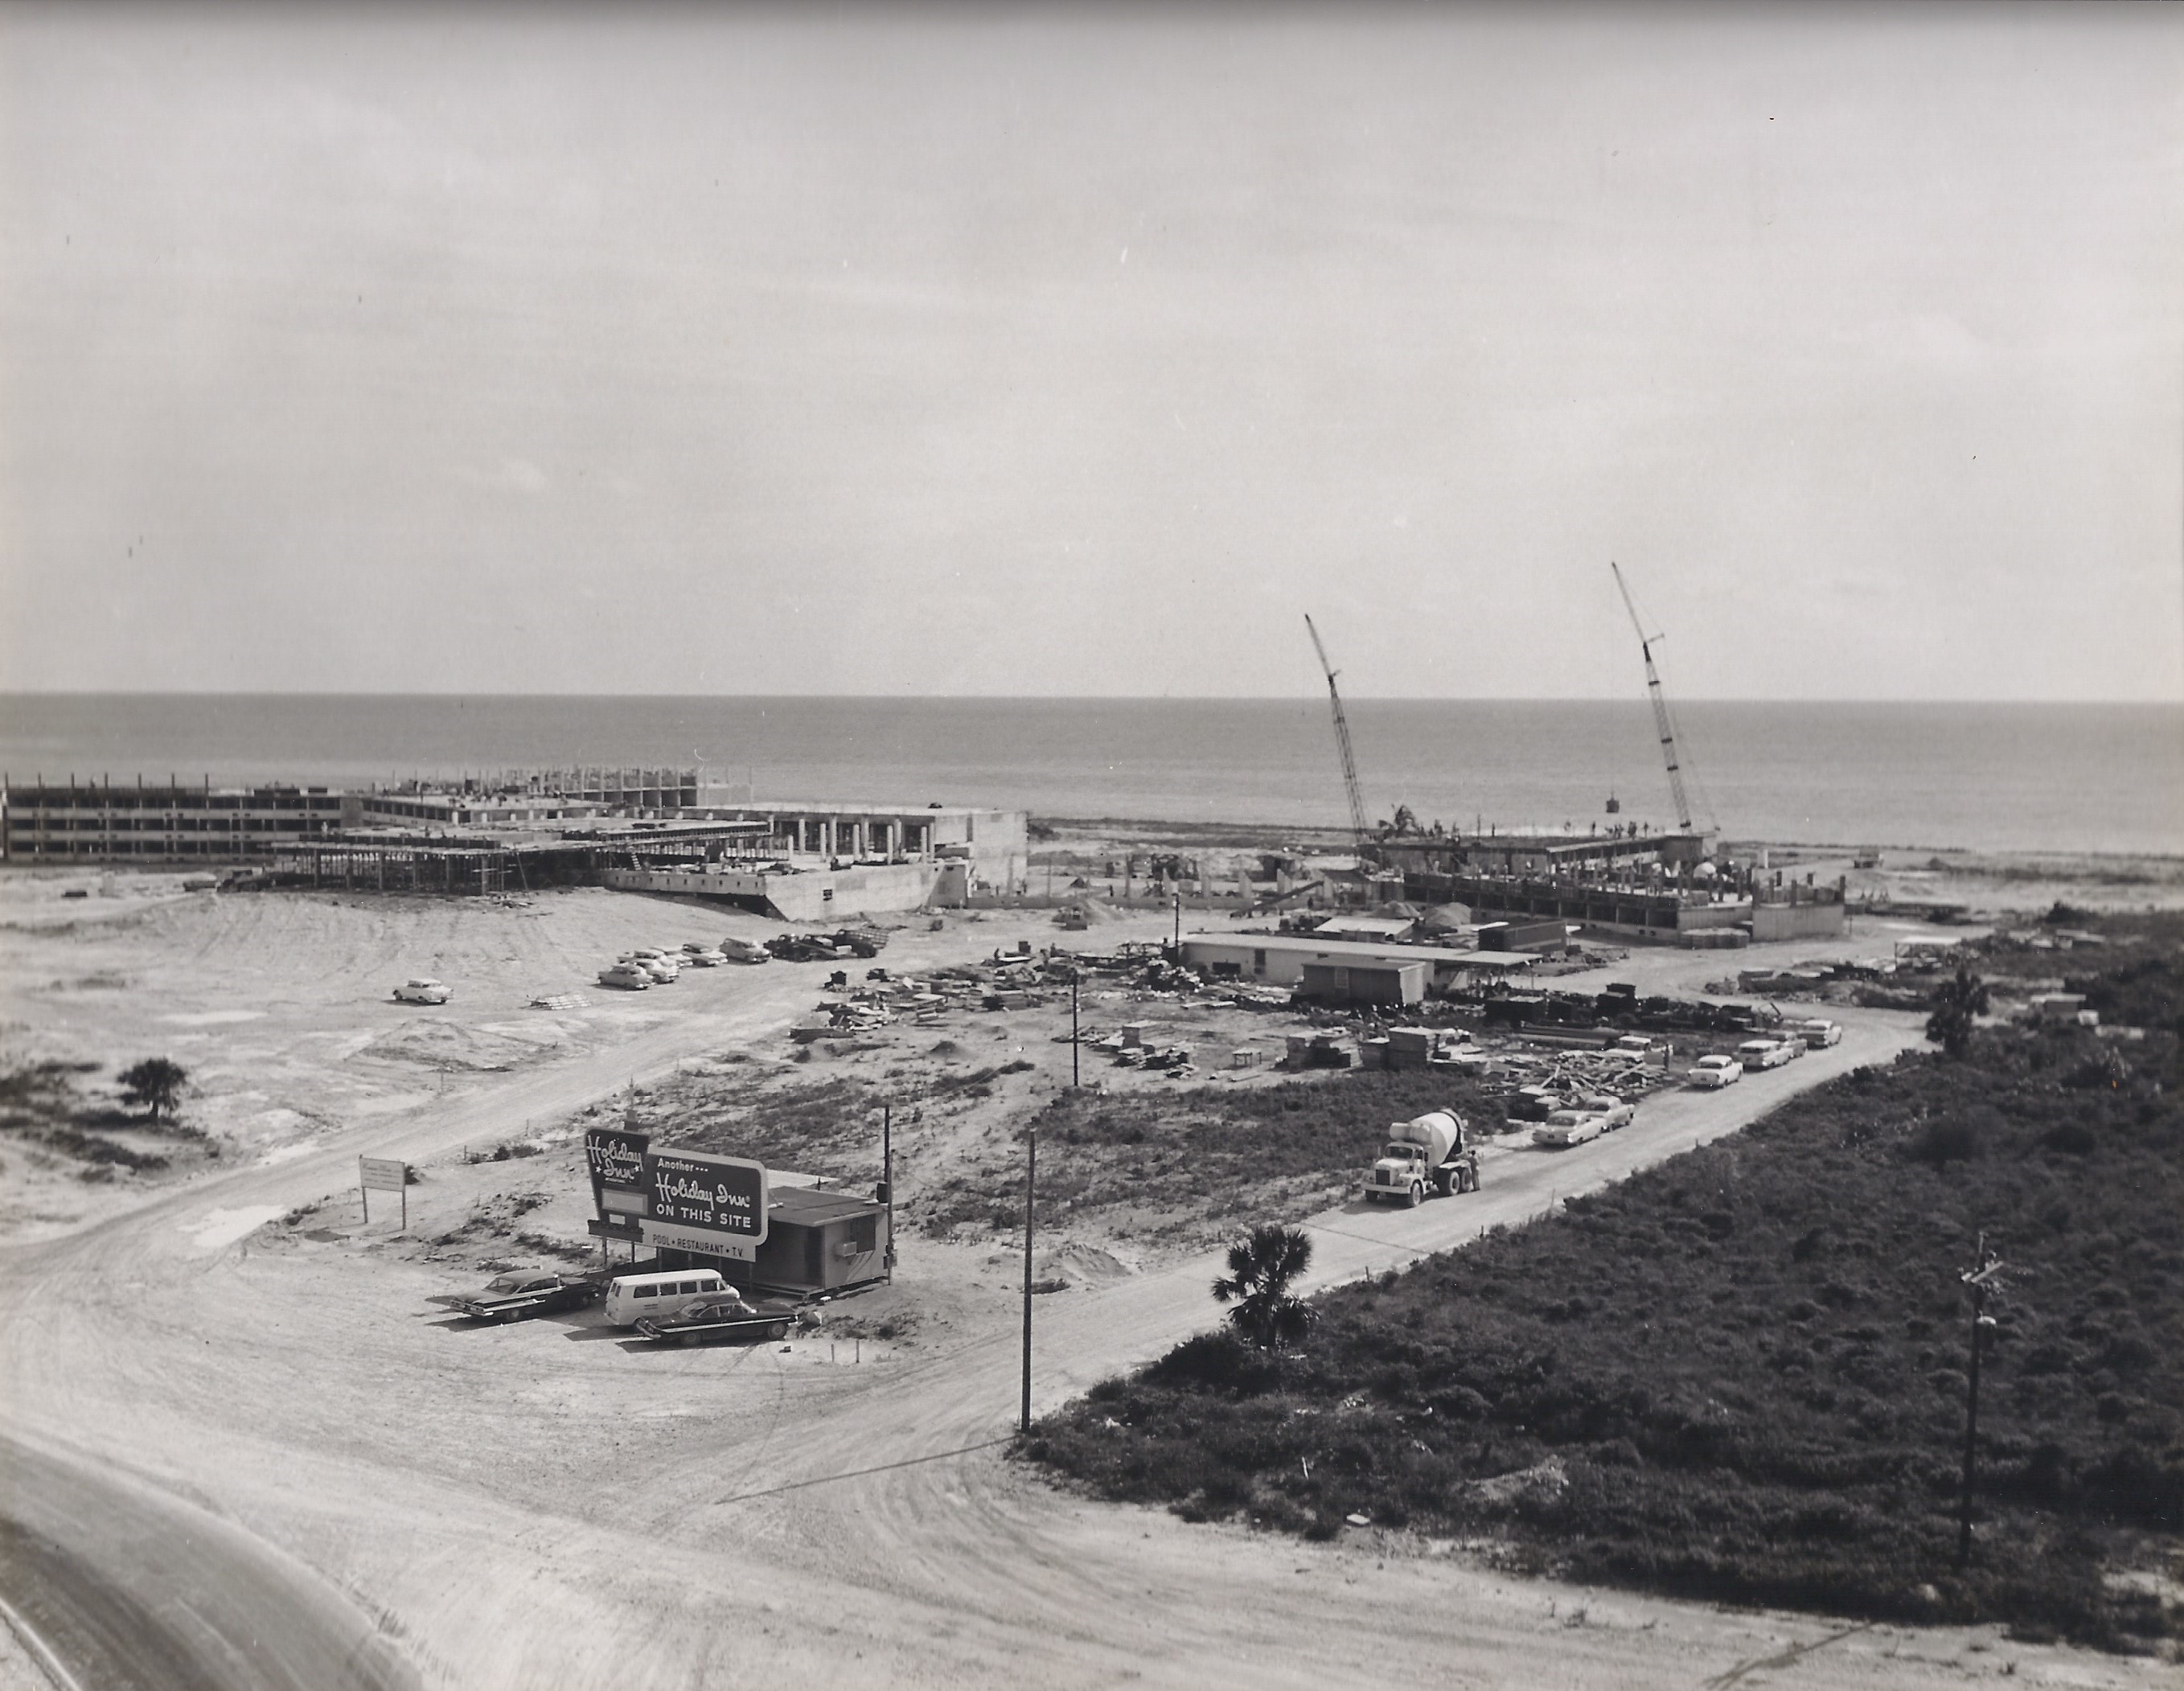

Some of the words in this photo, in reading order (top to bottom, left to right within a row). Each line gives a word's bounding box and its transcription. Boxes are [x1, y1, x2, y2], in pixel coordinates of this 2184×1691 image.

[586, 1135, 643, 1172] Holiday
[603, 1158, 634, 1180] Inn
[655, 1172, 714, 1211] Holiday
[716, 1184, 750, 1208] Inn
[656, 1204, 674, 1216] ON
[680, 1207, 712, 1222] THIS
[720, 1213, 751, 1228] SITE
[652, 1233, 670, 1246] POOL
[677, 1238, 724, 1254] RESTAURANT
